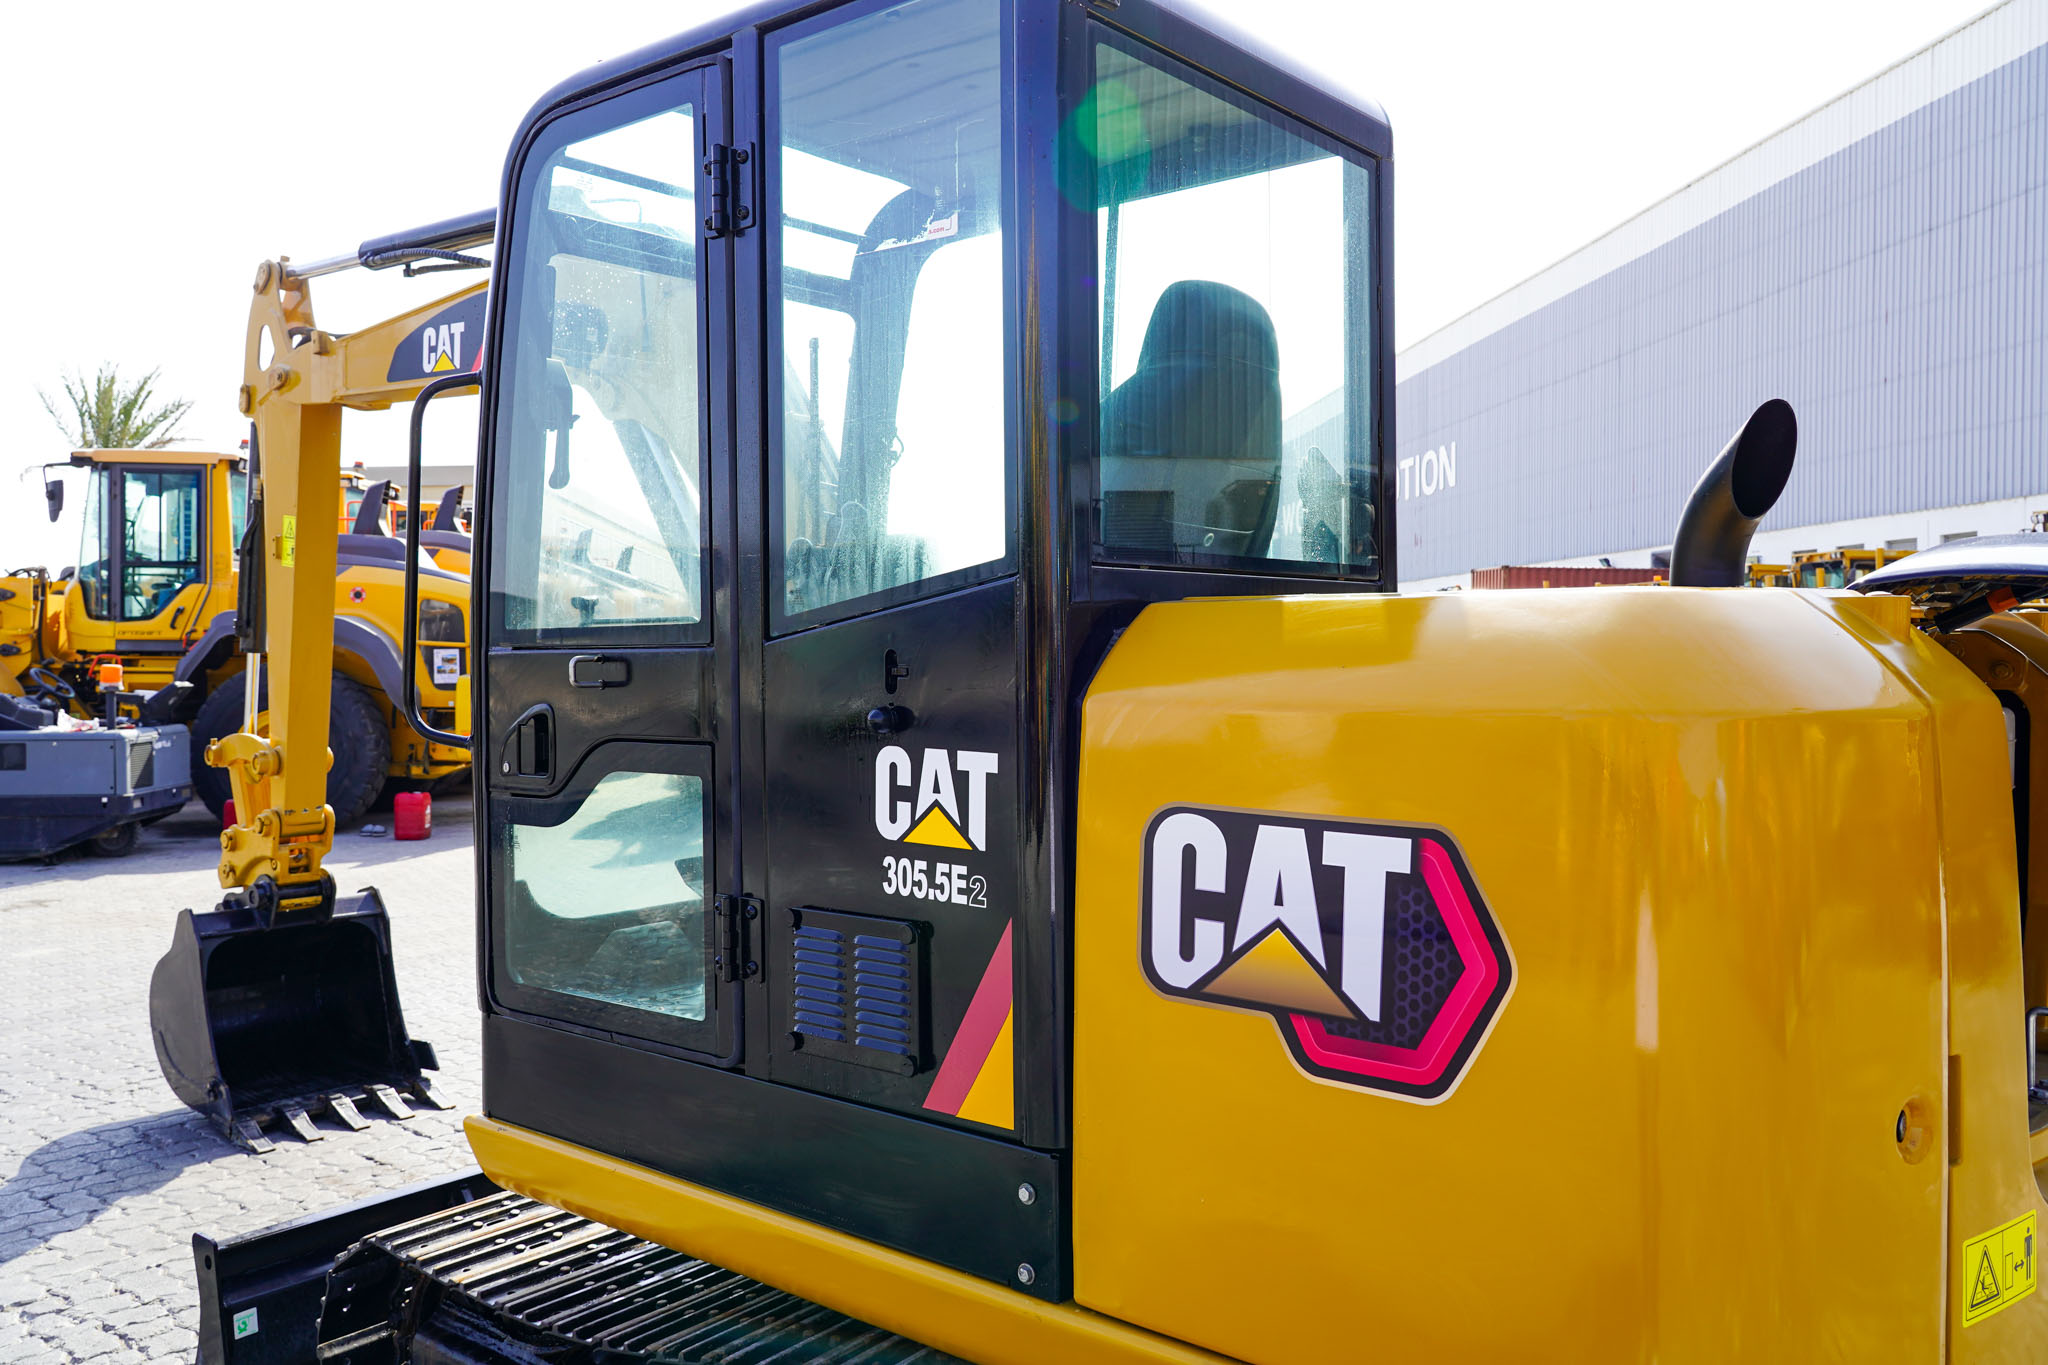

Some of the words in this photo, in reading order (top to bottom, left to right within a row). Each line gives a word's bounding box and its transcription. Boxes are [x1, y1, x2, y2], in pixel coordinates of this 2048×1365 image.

[422, 322, 465, 373] CAT
[1396, 441, 1457, 501] TION
[875, 745, 999, 852] CAT
[882, 855, 987, 909] 305.5E2
[1151, 812, 1413, 1023] CAT
